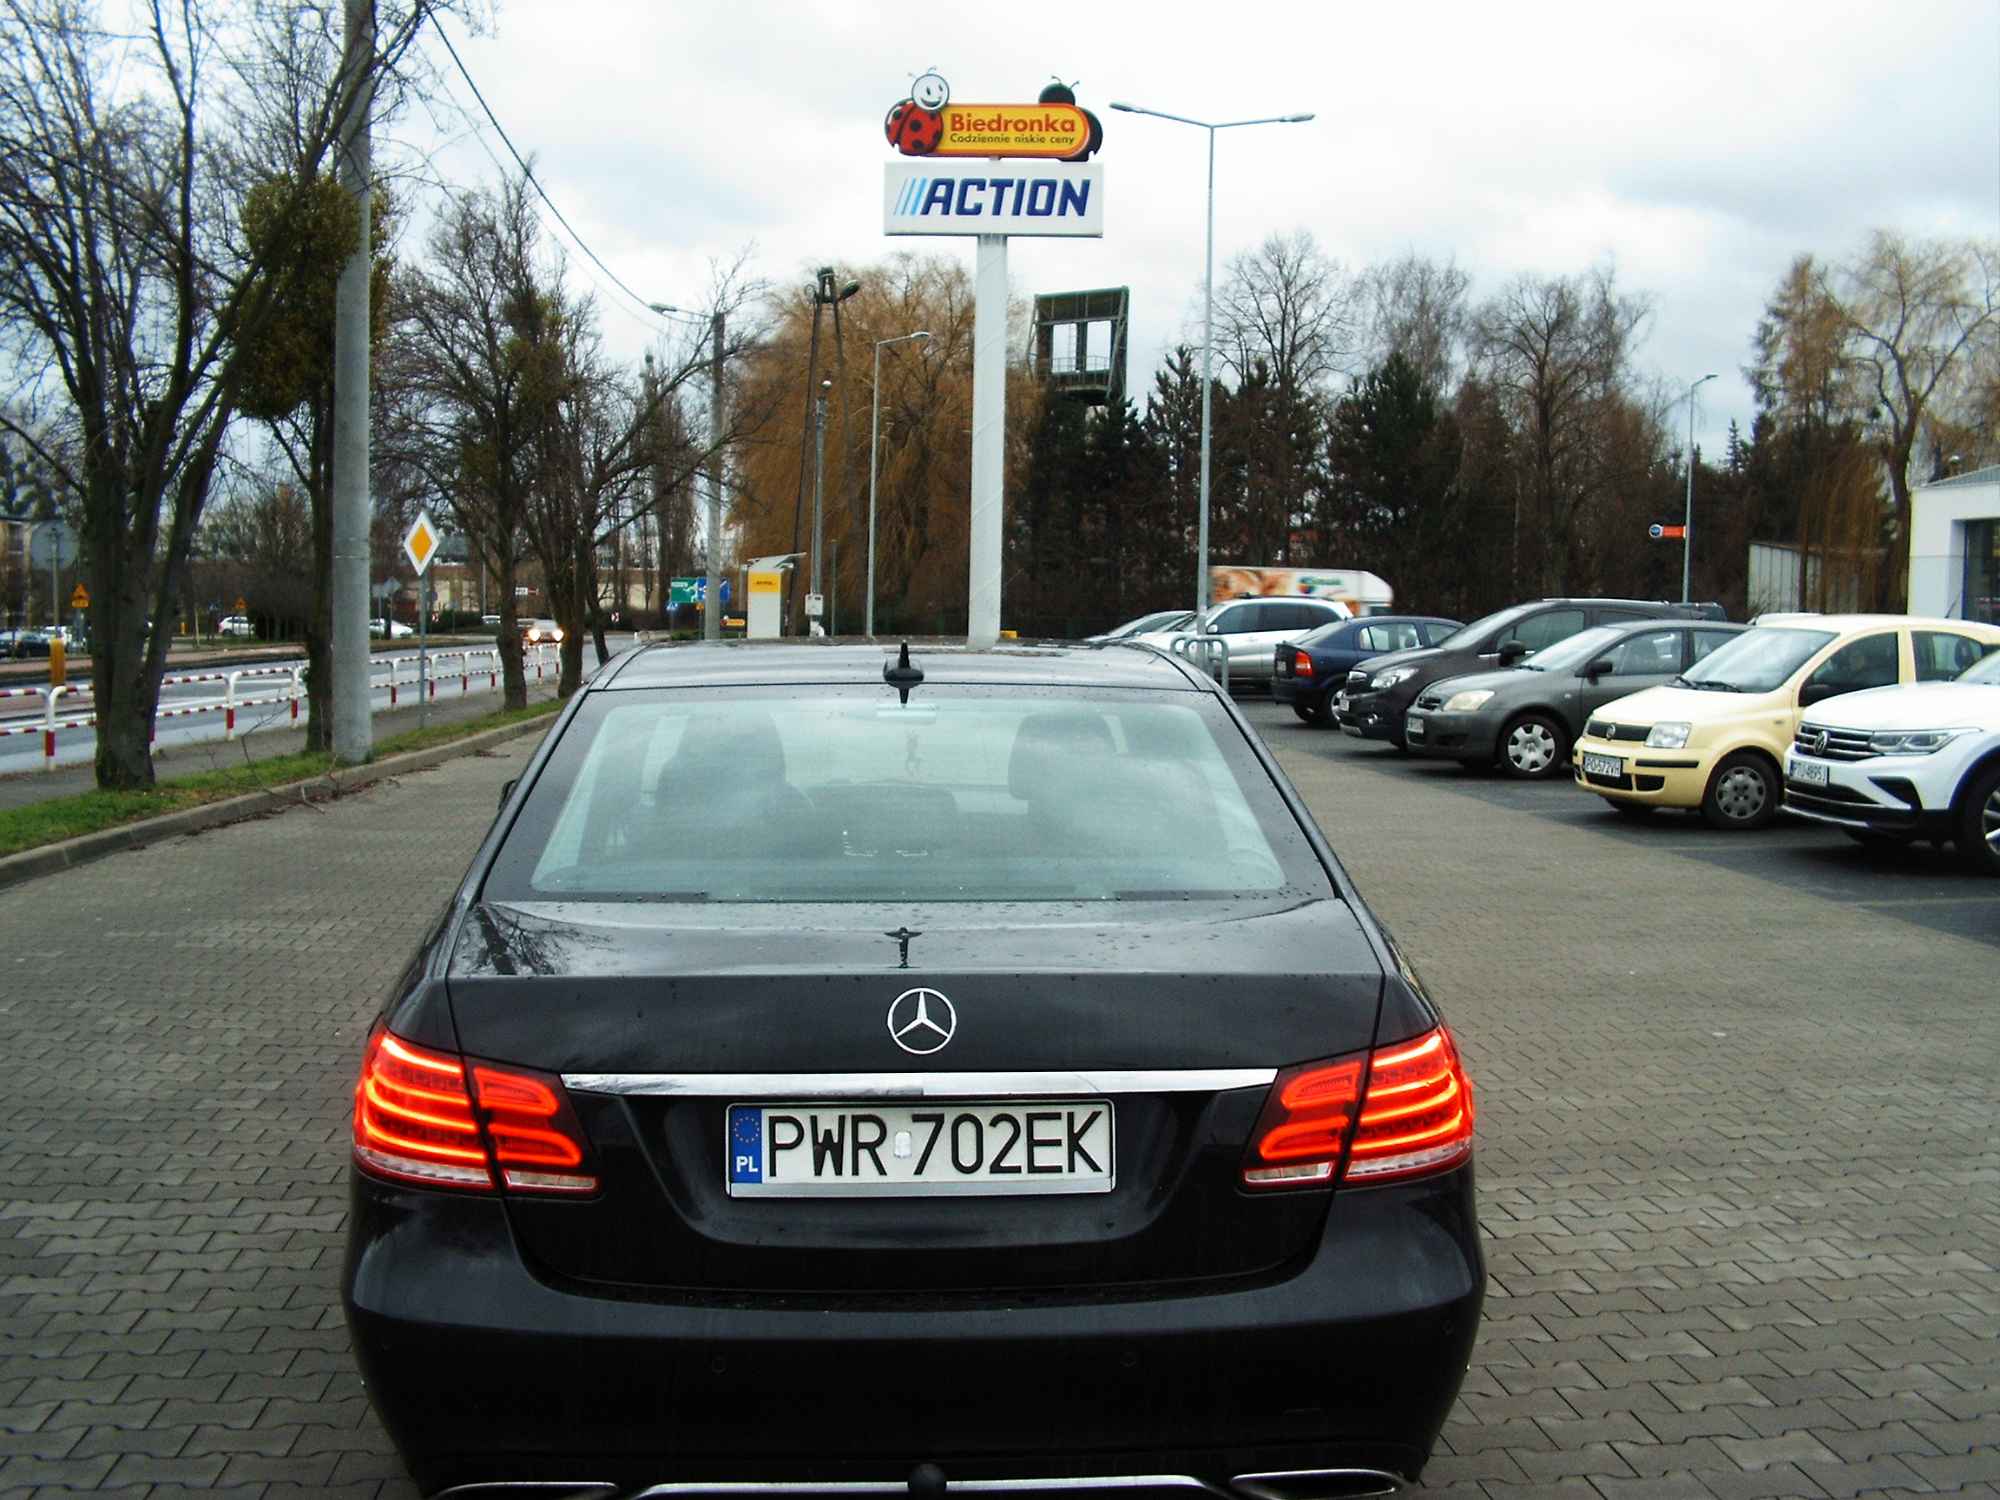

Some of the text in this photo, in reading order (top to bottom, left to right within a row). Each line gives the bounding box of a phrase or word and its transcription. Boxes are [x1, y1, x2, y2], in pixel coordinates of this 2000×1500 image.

[951, 112, 1076, 132] Biedronka
[950, 132, 1075, 145] Codziennie niskie ceny
[920, 178, 1092, 217] ACTION
[768, 1110, 1103, 1177] PWR 702EK
[736, 1155, 759, 1173] PL
